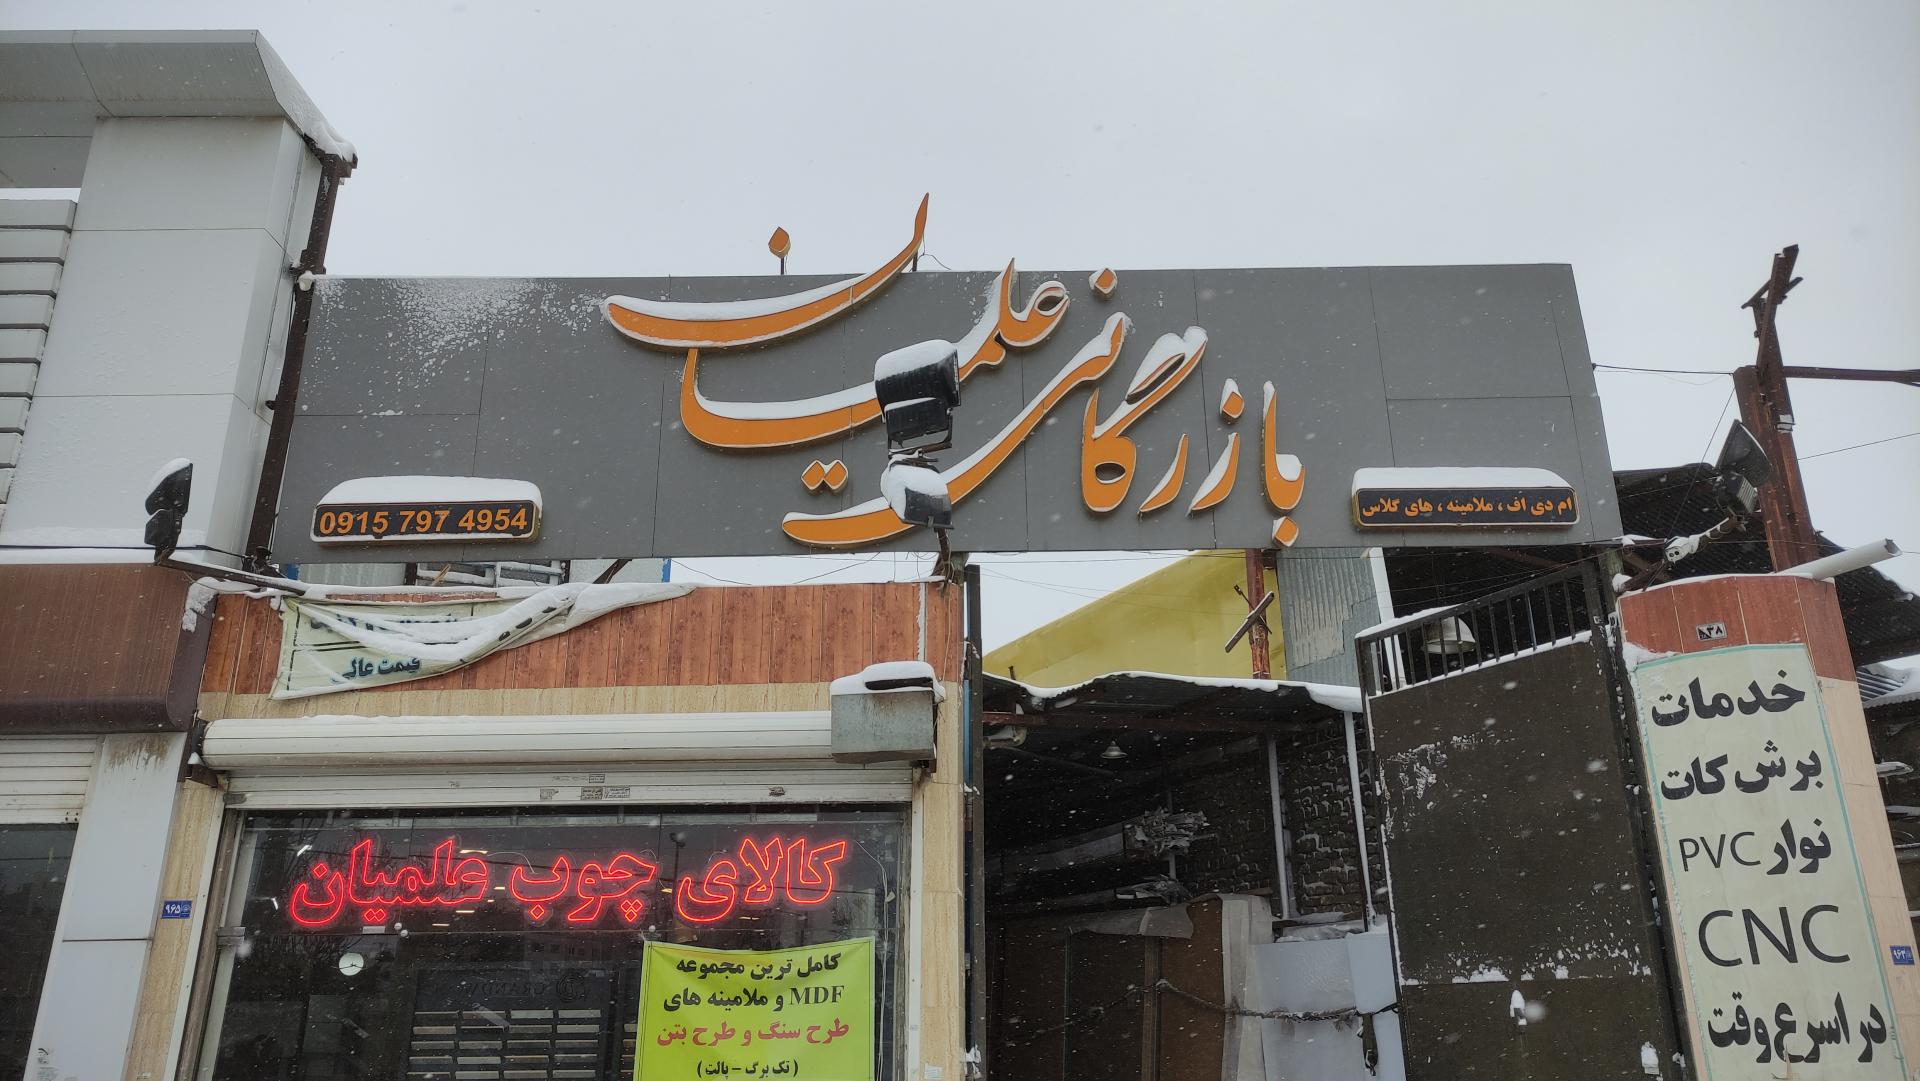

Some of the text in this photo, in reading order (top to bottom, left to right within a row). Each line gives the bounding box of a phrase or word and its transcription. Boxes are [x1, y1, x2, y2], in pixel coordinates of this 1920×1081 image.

[1404, 497, 1433, 518] های
[1506, 496, 1527, 513] اف
[1530, 500, 1553, 516] دی
[1557, 497, 1573, 515] ام
[319, 508, 528, 534] 0915 797 4954
[377, 656, 421, 676] قیمت
[1651, 669, 1806, 727] خدمات
[1660, 739, 1824, 801] برش کات
[1679, 818, 1832, 876] نوار PVC
[290, 836, 847, 924] کالای چوب علمیان
[1698, 904, 1851, 968] CNC
[676, 953, 842, 981] کامل ترین مجموعه
[663, 985, 845, 1012] MDF و ملامینه های
[656, 1016, 850, 1047] طرح سنگ و طرح بتن
[1707, 991, 1888, 1064] در اسرع وقت
